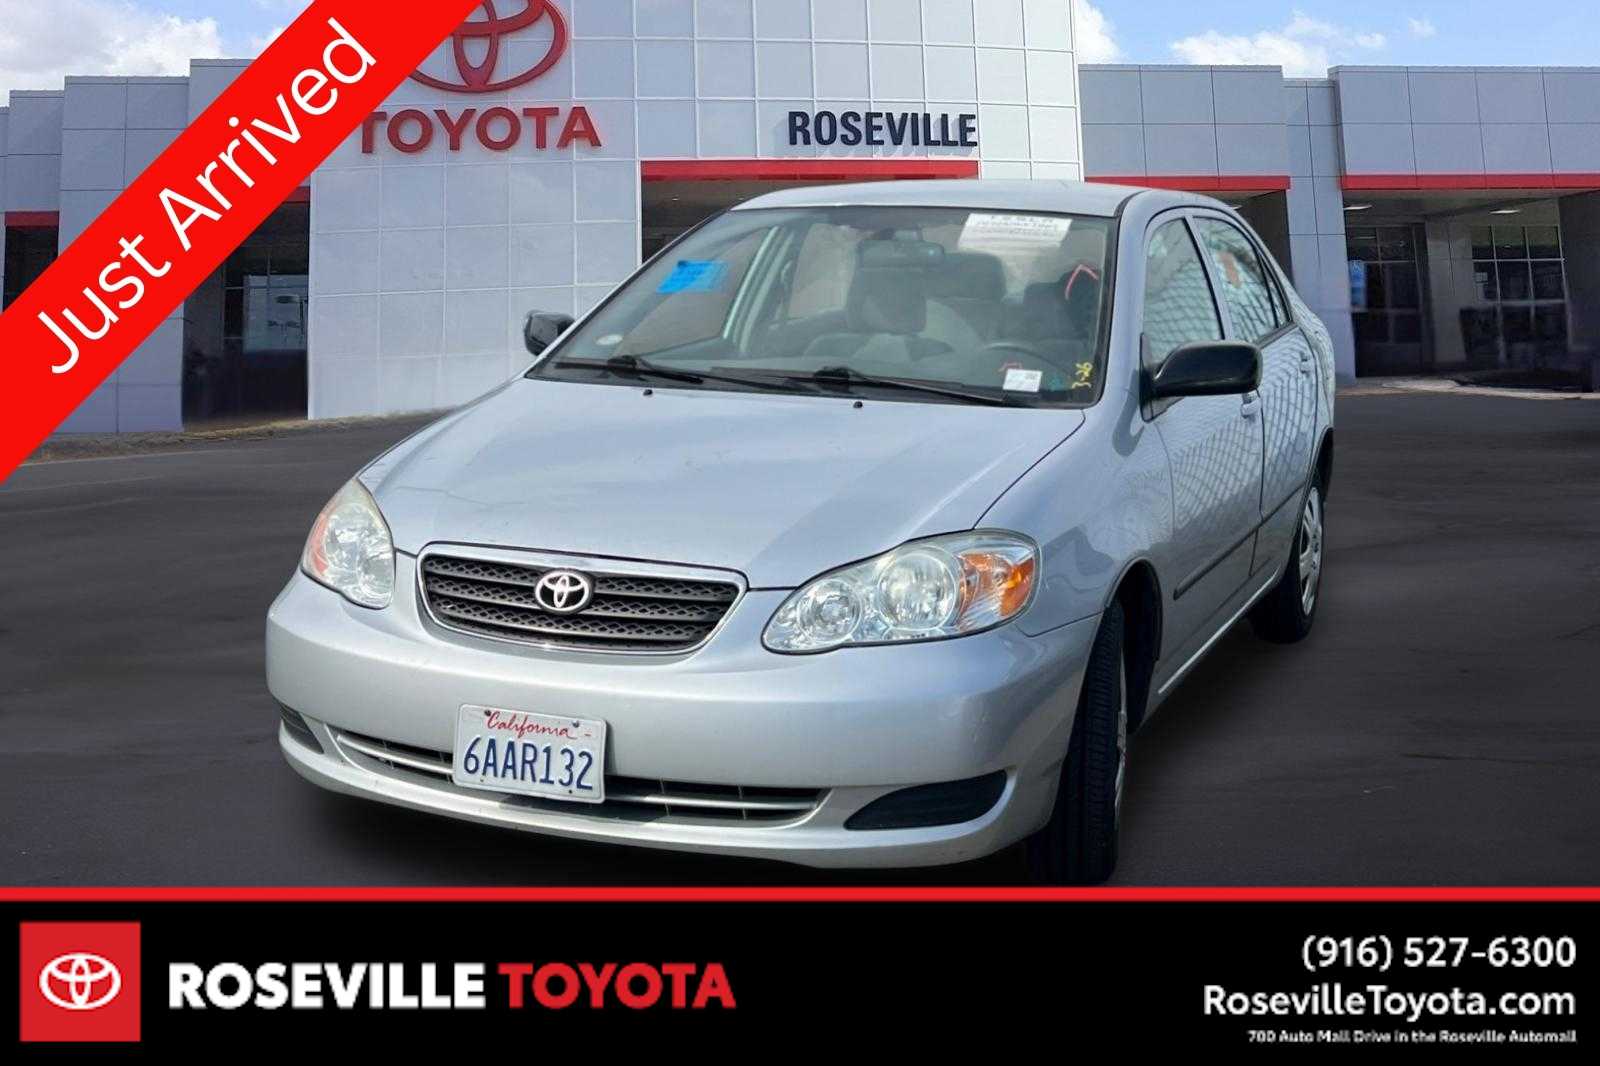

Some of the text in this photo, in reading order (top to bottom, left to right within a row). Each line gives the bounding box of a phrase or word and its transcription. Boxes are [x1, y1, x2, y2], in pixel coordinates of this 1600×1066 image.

[361, 105, 602, 154] TOYOTA
[788, 110, 978, 147] ROSEVILLE
[486, 710, 578, 740] California
[463, 736, 593, 790] 6AAR132
